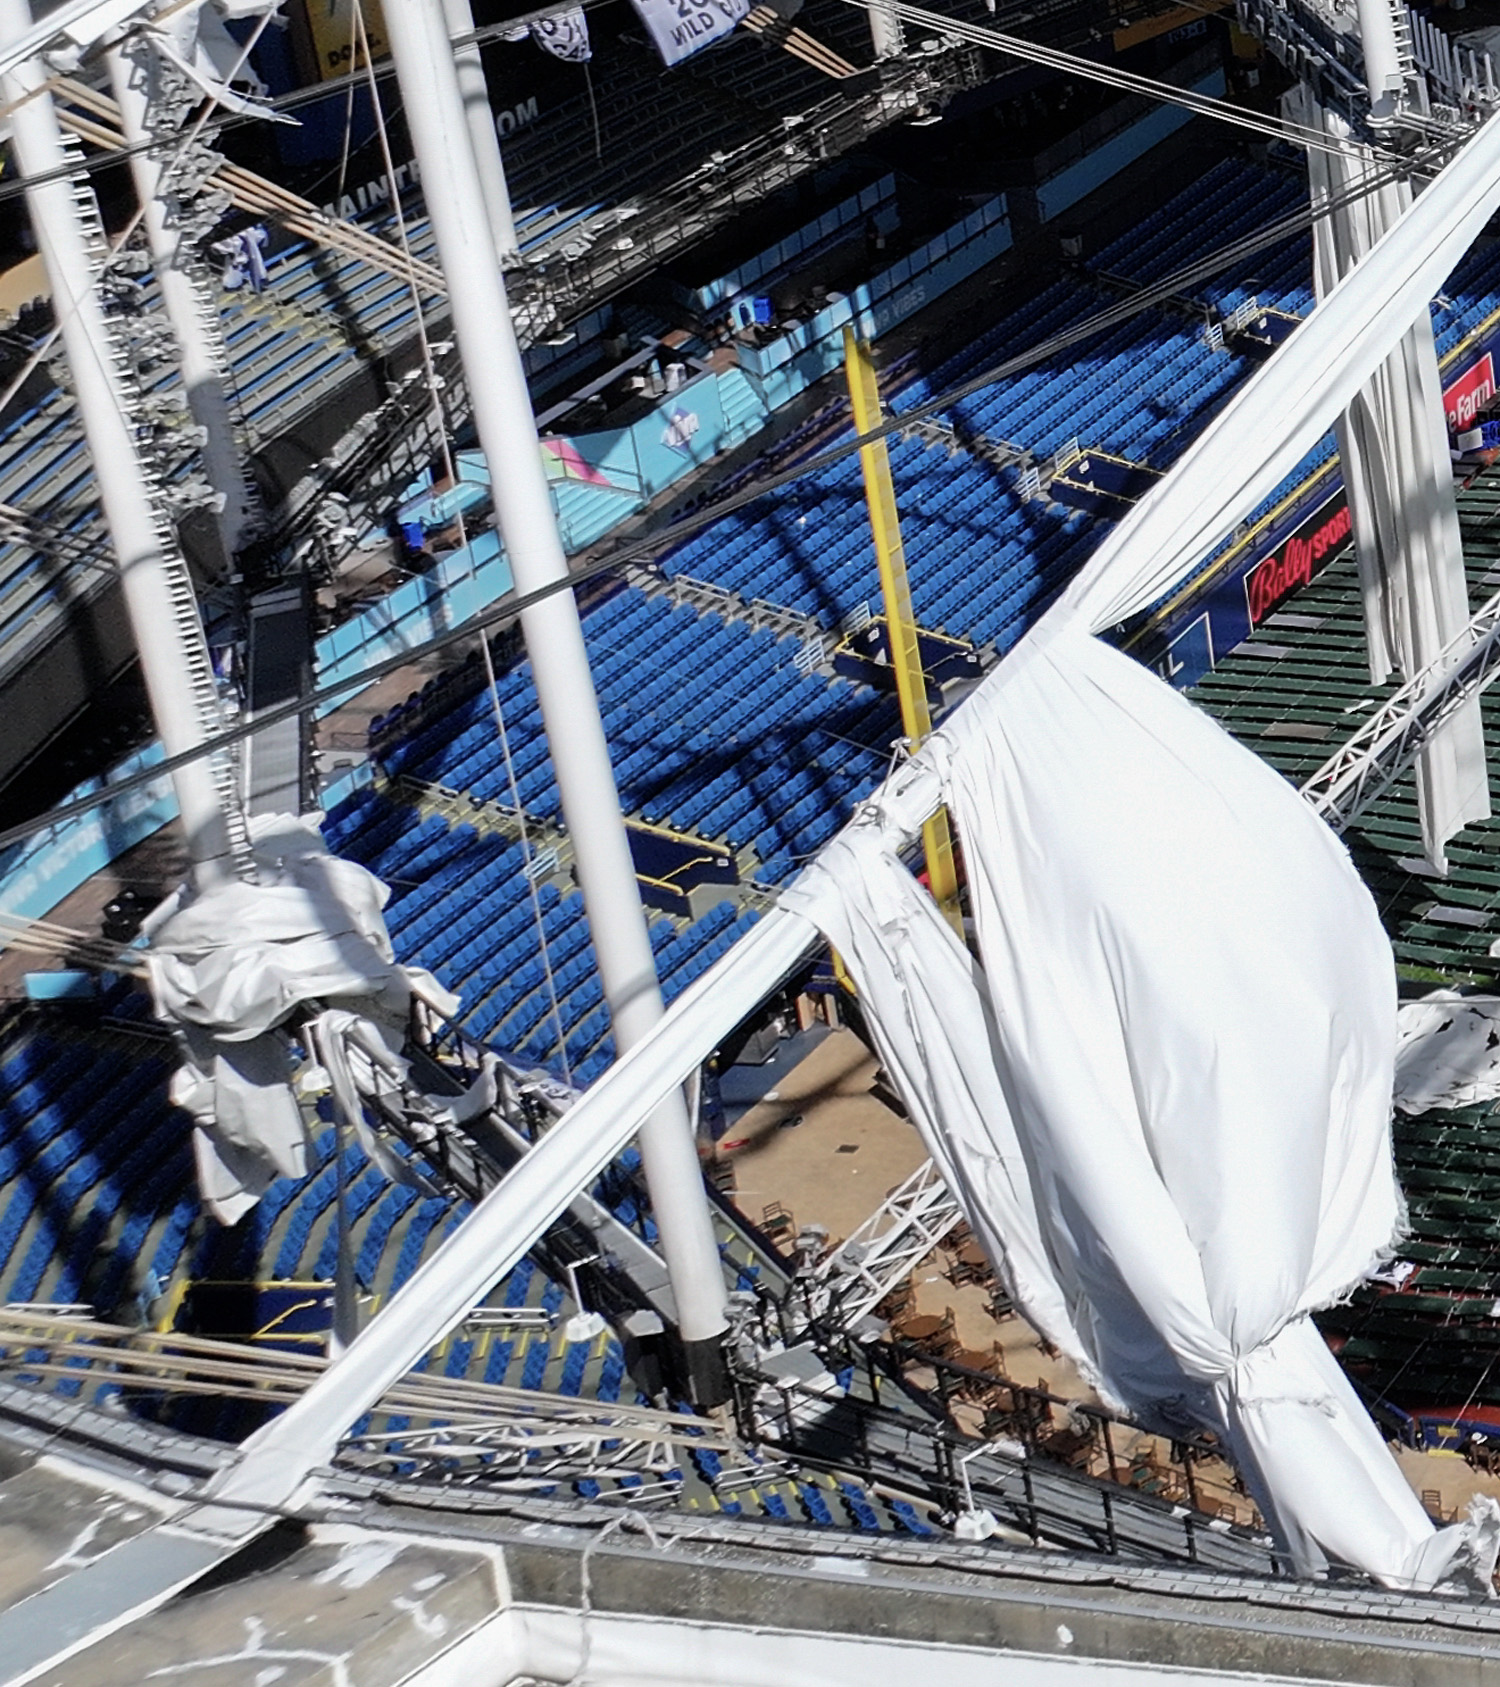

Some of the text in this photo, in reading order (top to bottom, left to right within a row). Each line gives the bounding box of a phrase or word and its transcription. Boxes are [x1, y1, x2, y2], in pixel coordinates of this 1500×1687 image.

[670, 11, 715, 48] WILD
[1457, 378, 1490, 425] Farm
[1251, 537, 1313, 624] Bally
